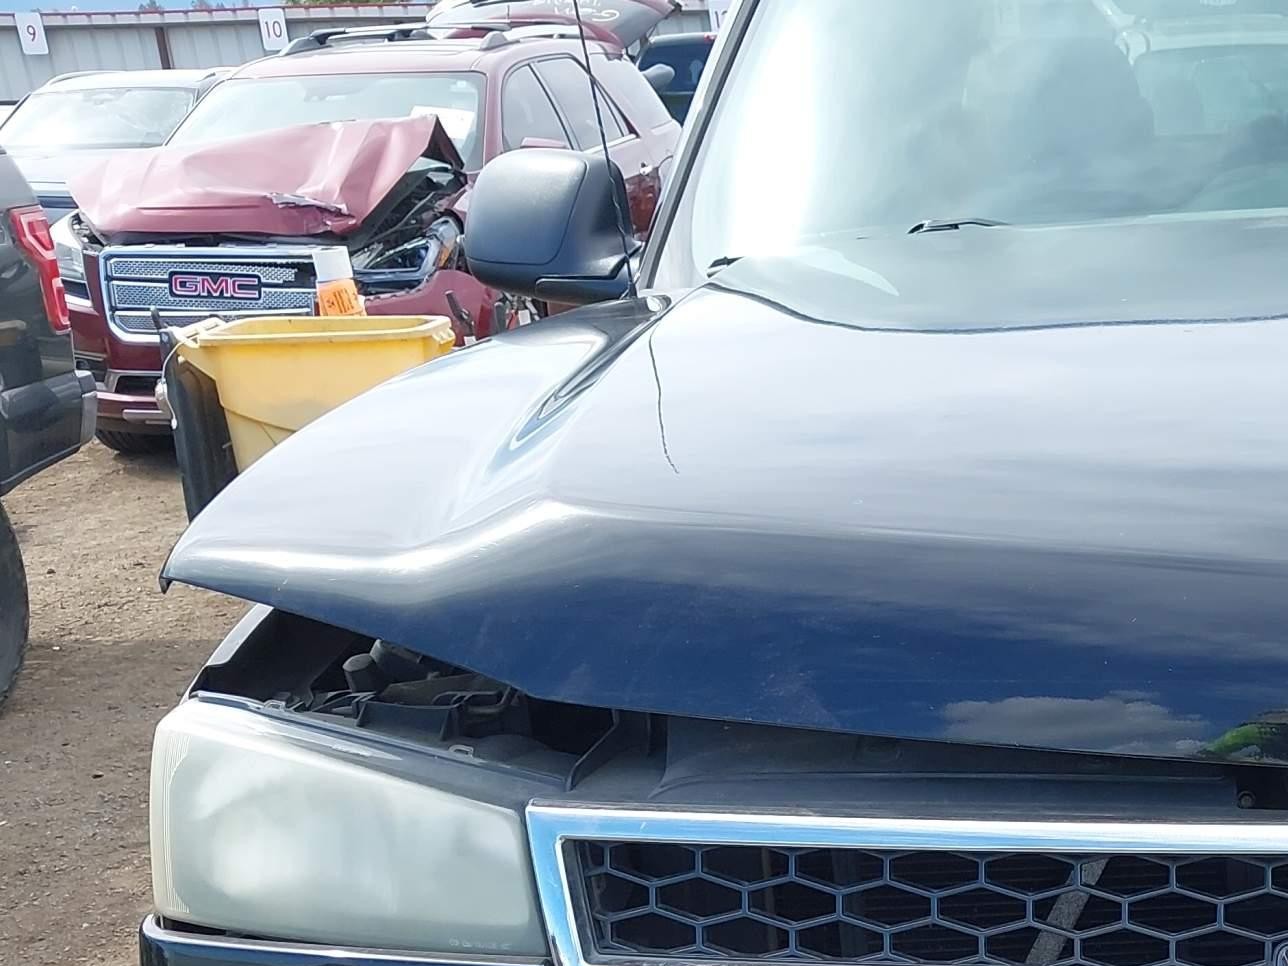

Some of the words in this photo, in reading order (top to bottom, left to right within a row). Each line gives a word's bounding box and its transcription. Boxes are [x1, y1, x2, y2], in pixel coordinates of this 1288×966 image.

[26, 24, 36, 42] 9
[264, 20, 283, 39] 10
[172, 274, 260, 299] GMC
